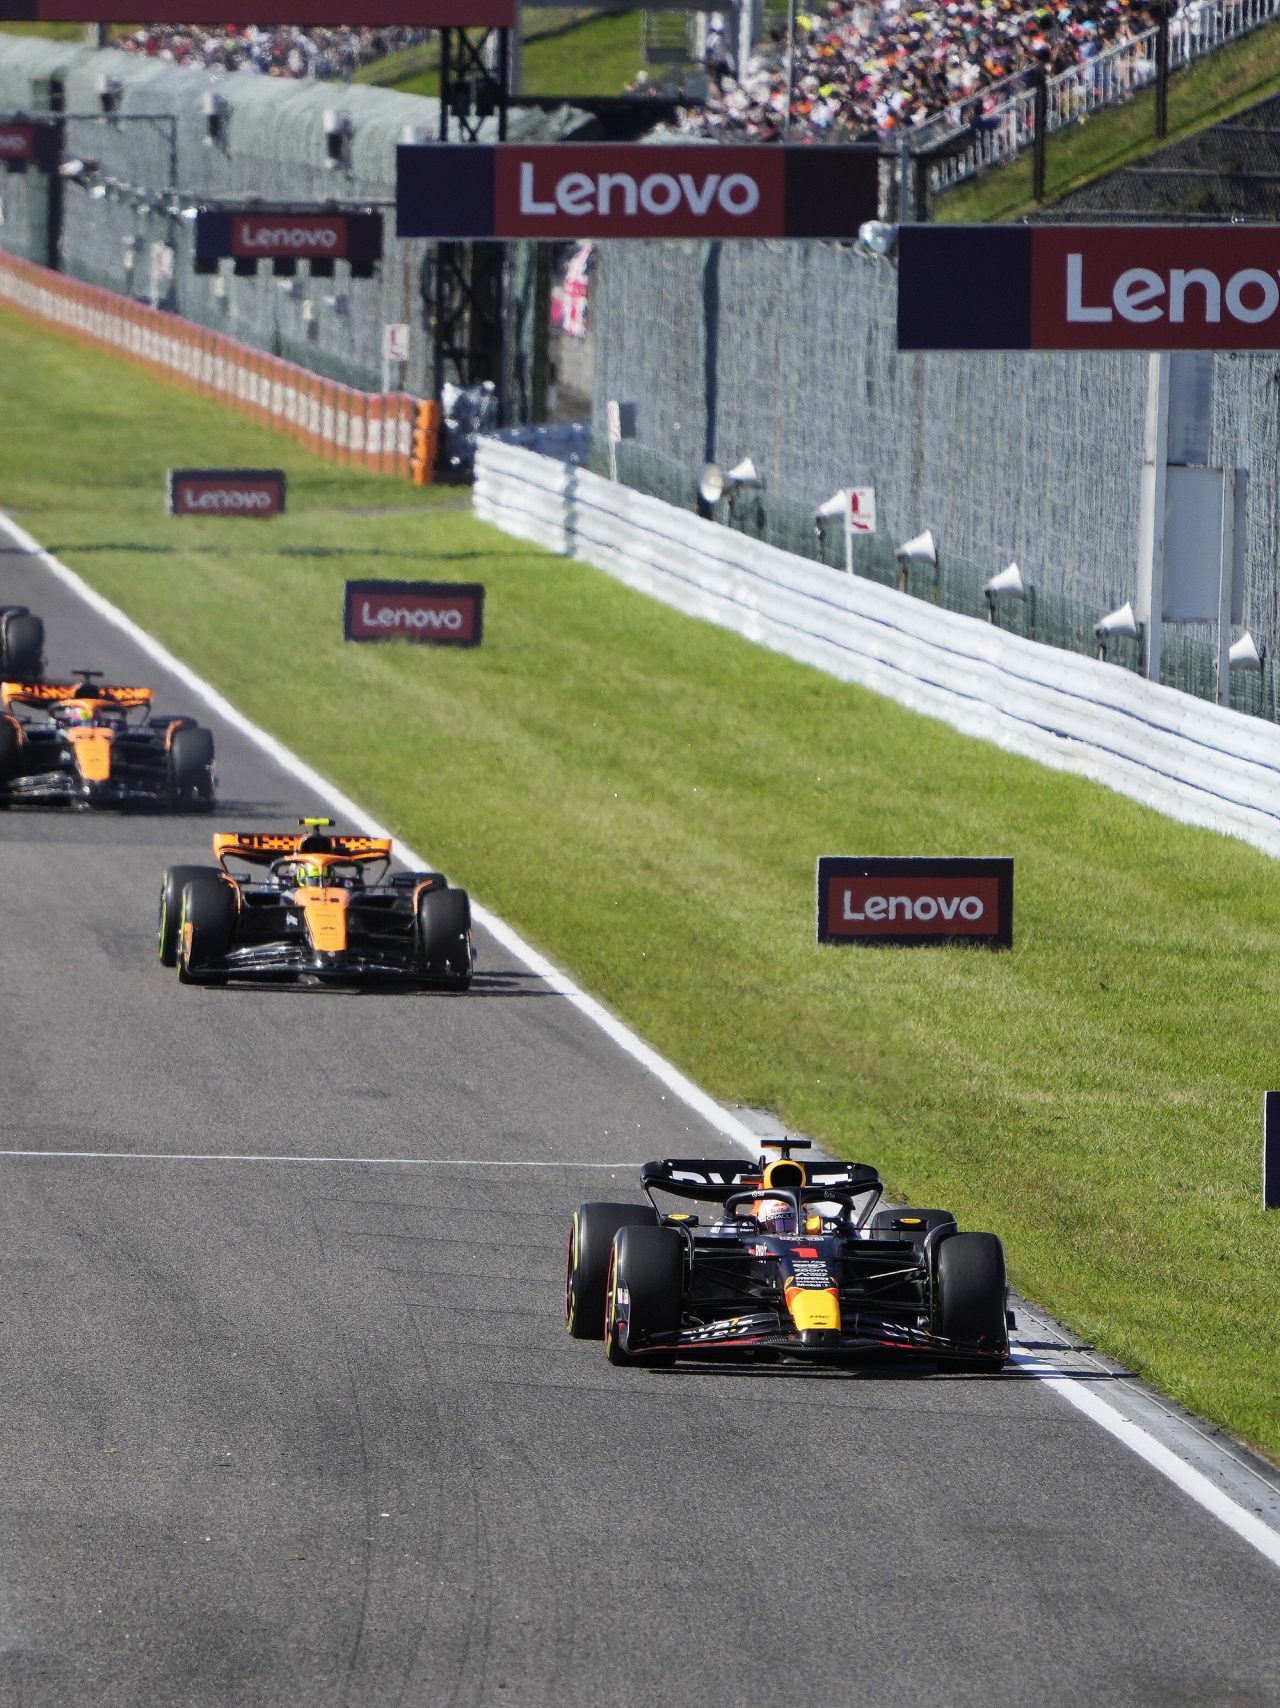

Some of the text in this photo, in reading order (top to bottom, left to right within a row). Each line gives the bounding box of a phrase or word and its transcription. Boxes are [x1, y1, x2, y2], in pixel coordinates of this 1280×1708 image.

[520, 162, 759, 216] Lenovo
[241, 224, 337, 248] Lenovo
[1066, 253, 1280, 324] Leno
[184, 488, 271, 509] Lenovo
[362, 602, 462, 630] Lenovo
[843, 890, 984, 920] Lenovo
